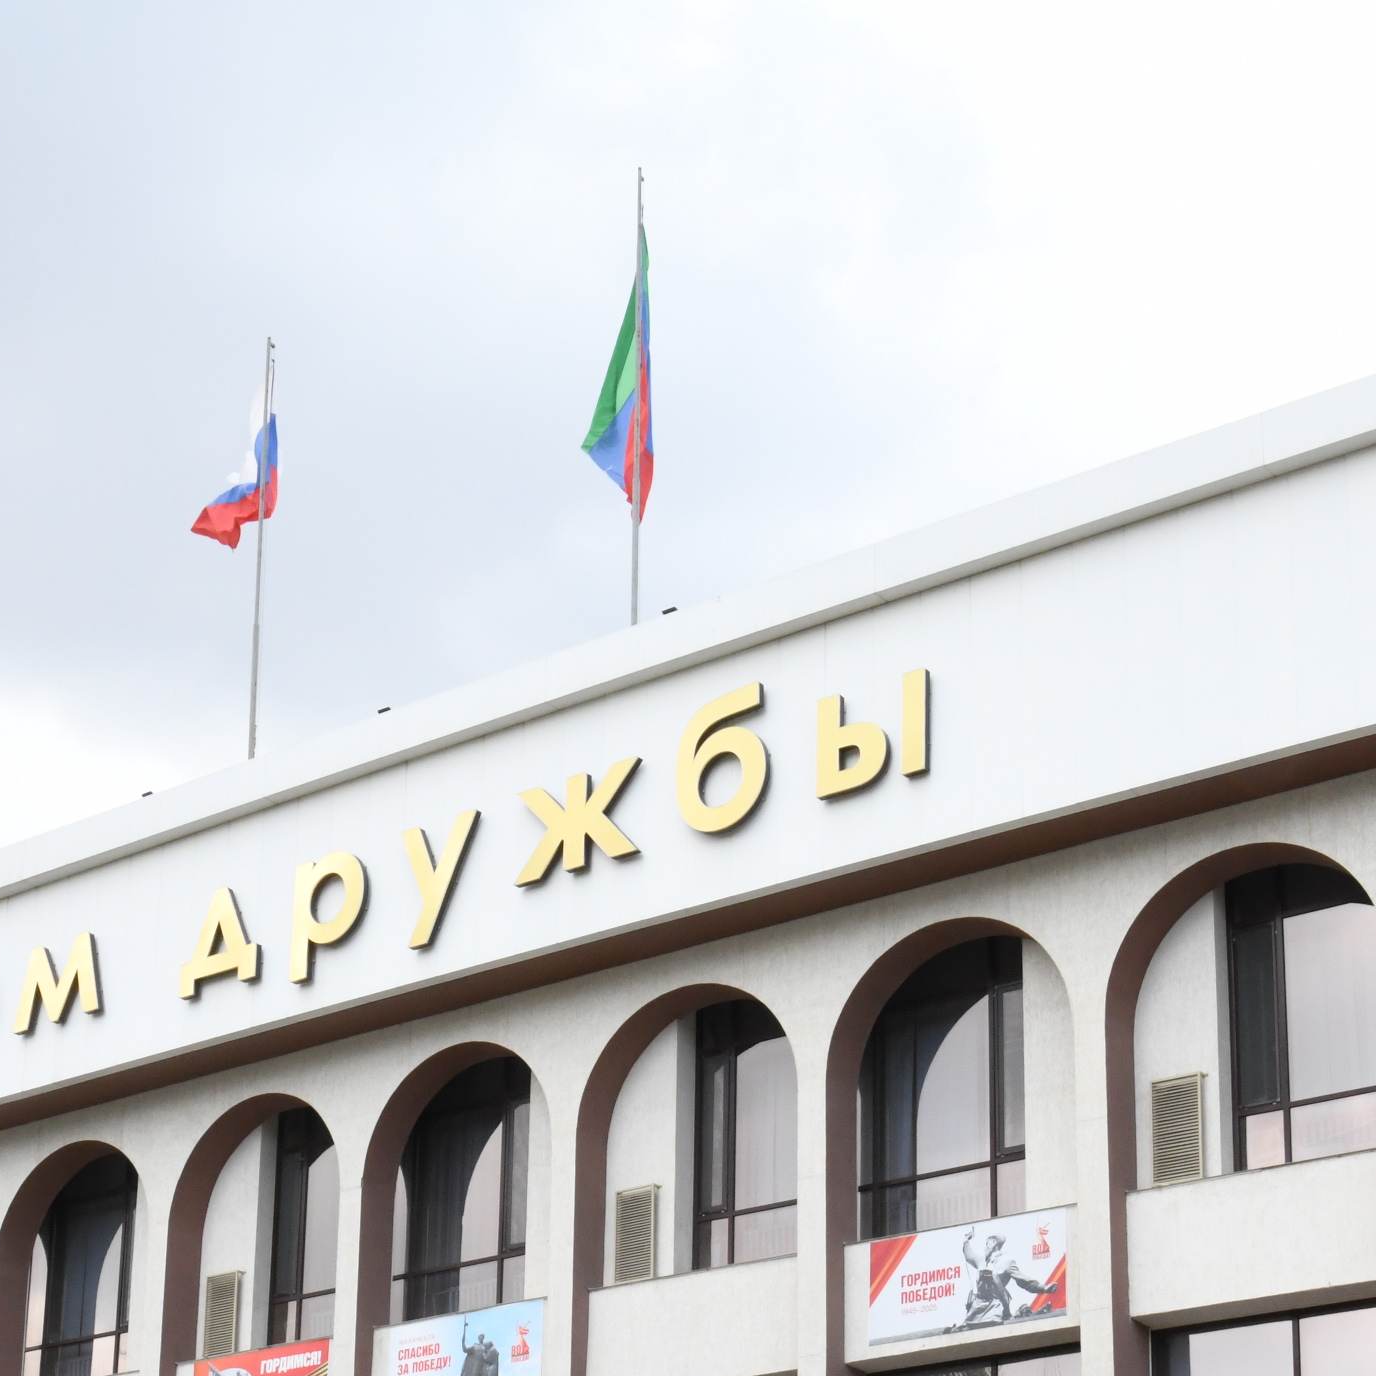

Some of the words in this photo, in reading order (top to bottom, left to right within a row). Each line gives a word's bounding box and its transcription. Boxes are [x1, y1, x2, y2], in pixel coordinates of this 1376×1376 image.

[901, 1266, 961, 1288] ГОРДИМСЯ
[901, 1284, 955, 1305] ПОБЕДОЙ!
[260, 1350, 322, 1375] ГОРДИМСЯ!
[398, 1343, 440, 1361] СПАСИБО
[397, 1363, 409, 1376] ЗА
[412, 1355, 451, 1374] ПОБЕДУ!
